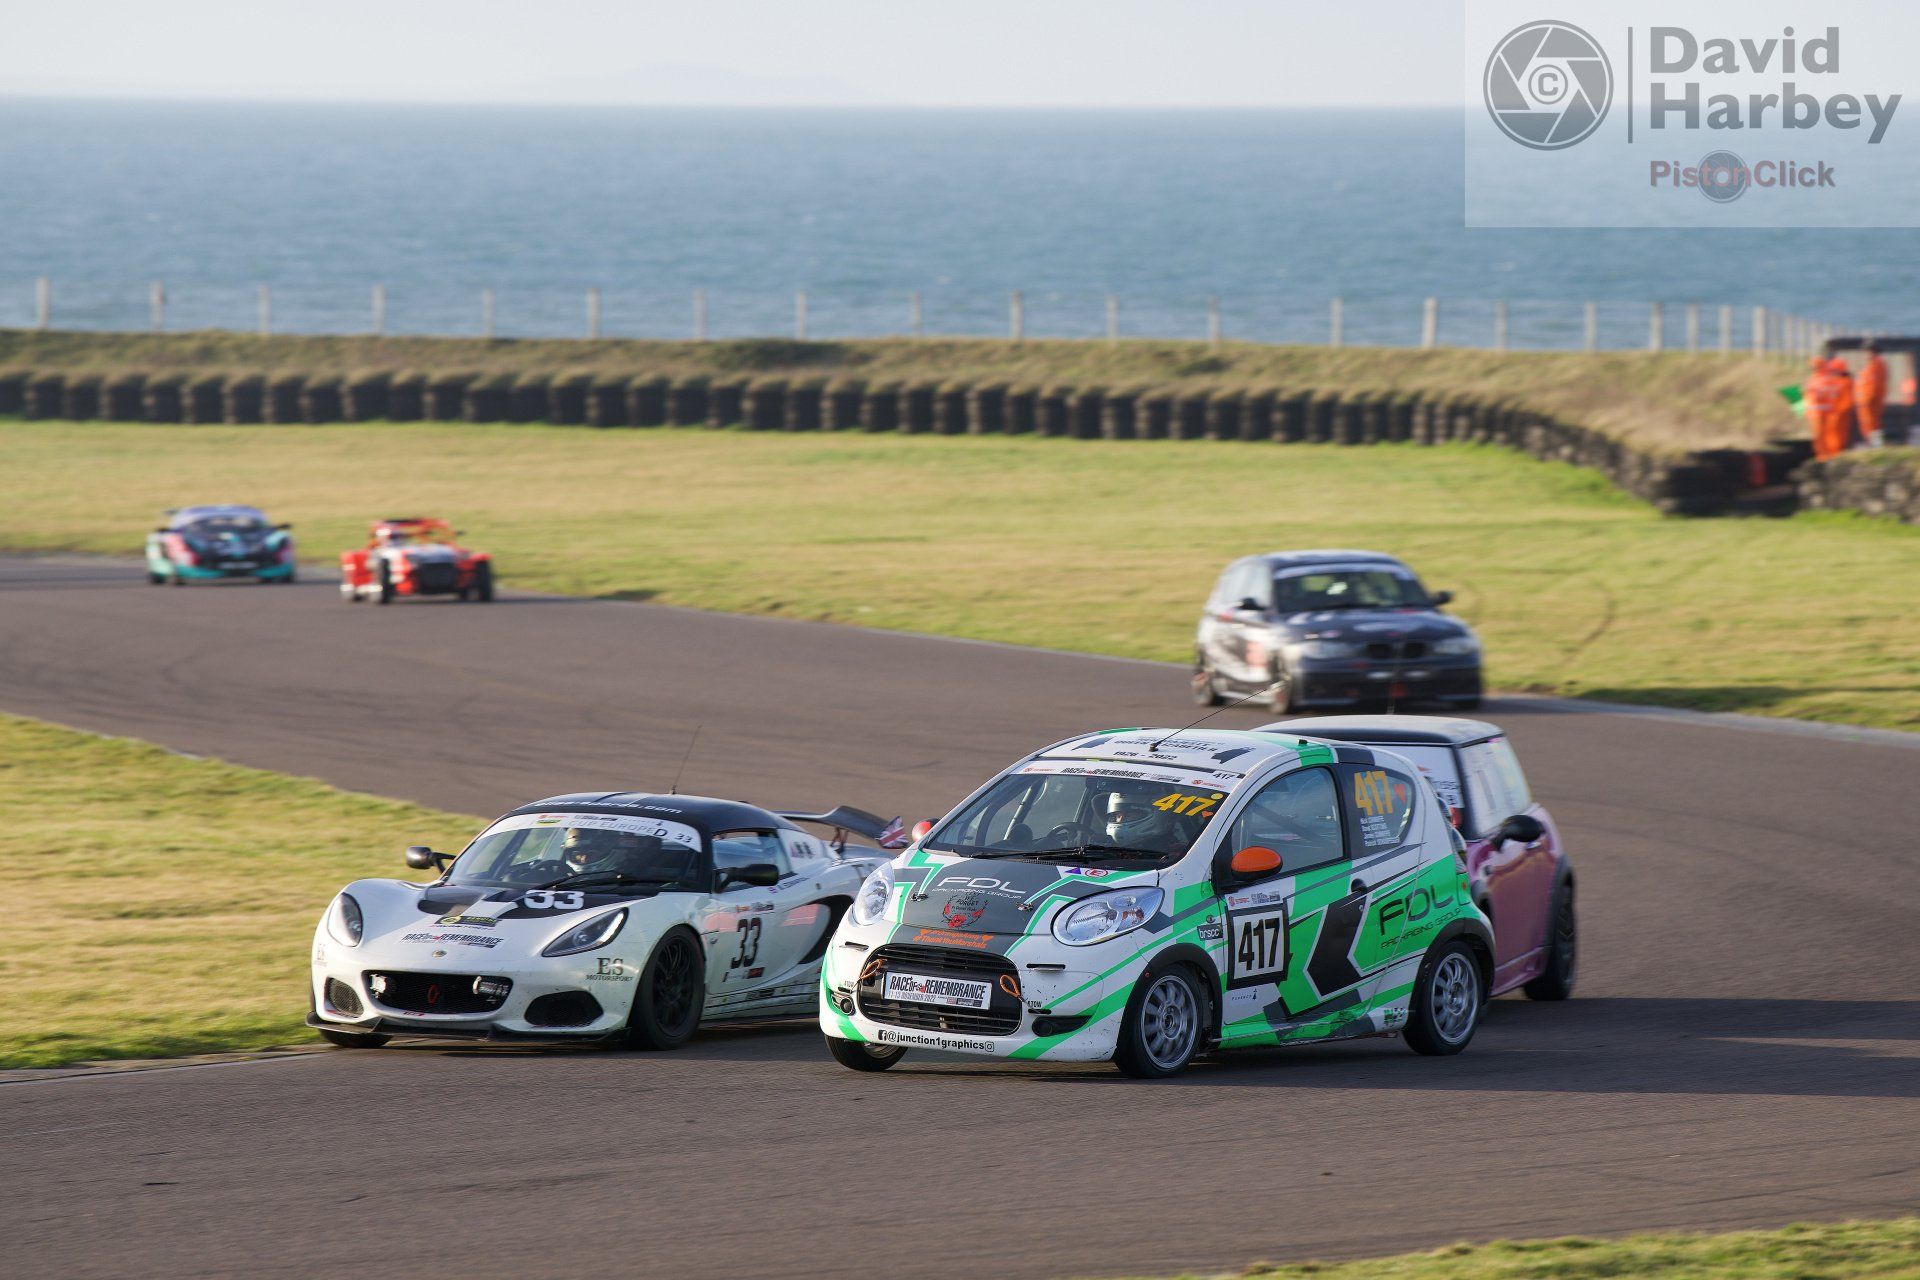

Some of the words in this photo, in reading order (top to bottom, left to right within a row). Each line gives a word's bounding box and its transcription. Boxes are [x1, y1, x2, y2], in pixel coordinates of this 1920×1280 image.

[1213, 772, 1235, 780] 417
[1354, 771, 1393, 816] 417
[1153, 793, 1217, 817] 417
[568, 820, 595, 828] CUP
[676, 833, 693, 844] 33
[937, 876, 1027, 894] FDL
[524, 889, 585, 910] 33
[1379, 884, 1454, 936] FDL
[731, 917, 762, 969] 33
[1238, 917, 1280, 971] 417
[596, 957, 624, 975] ES
[889, 975, 911, 992] RACE
[925, 979, 987, 999] REMEMBRANCE
